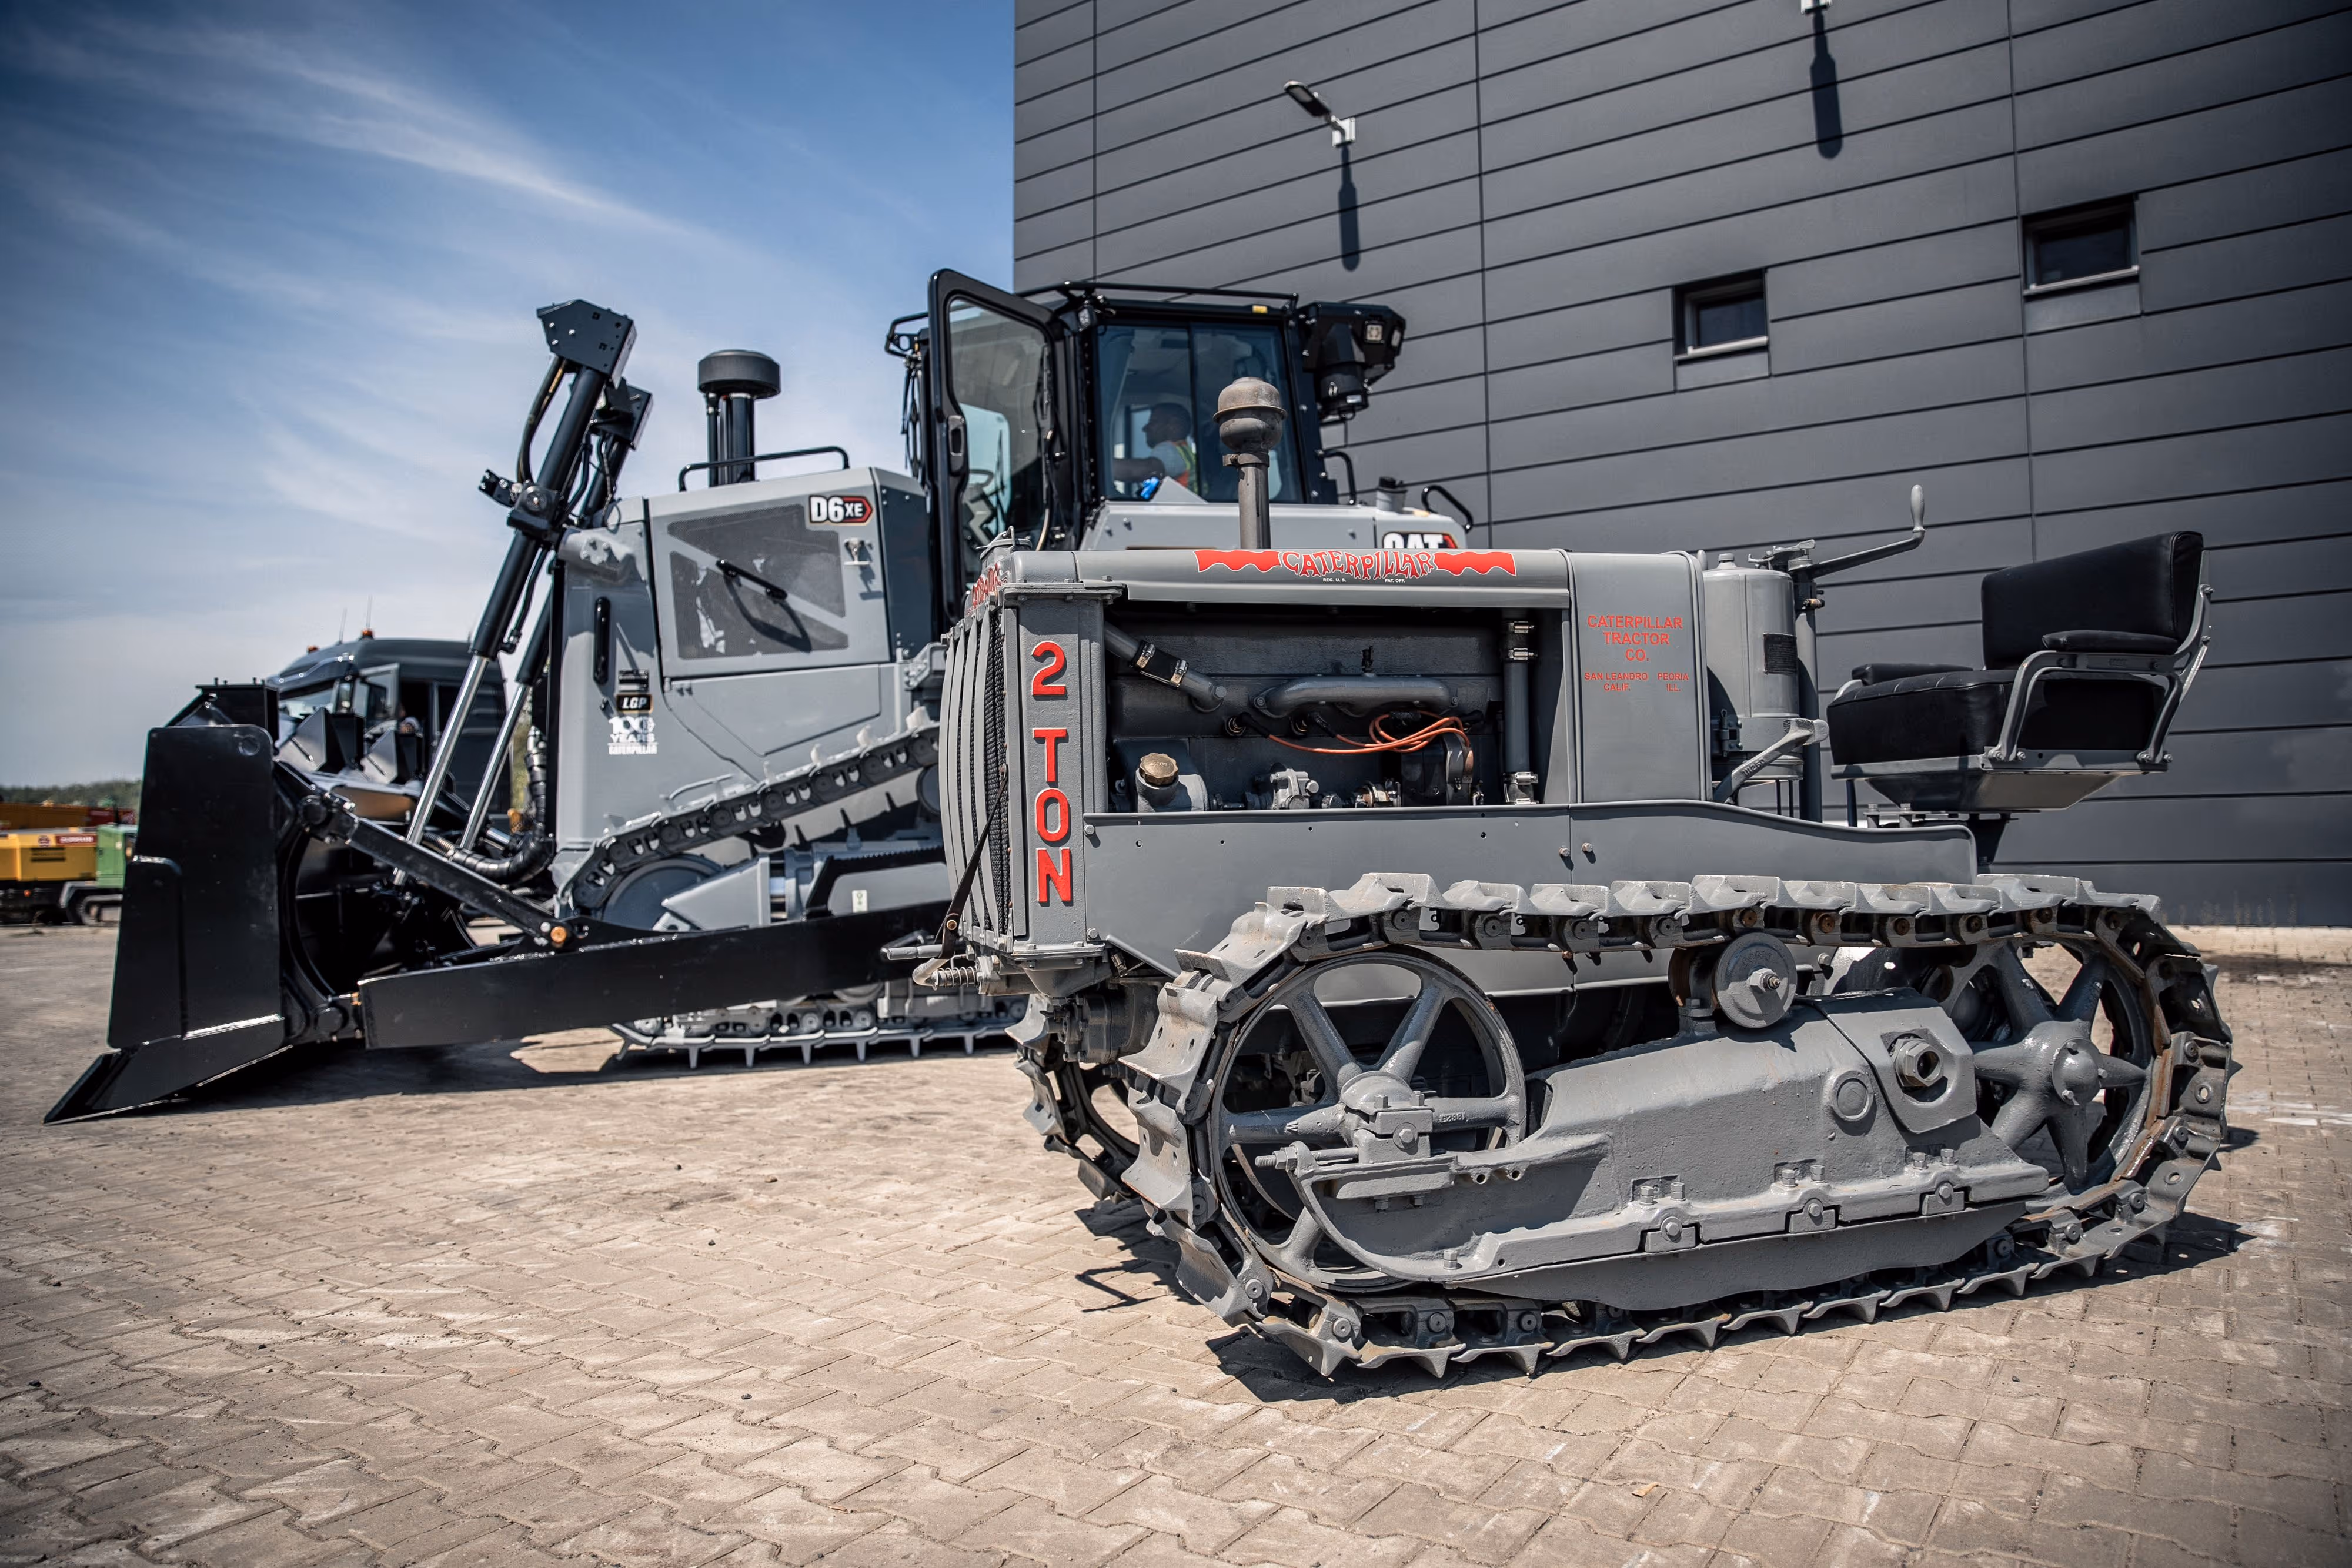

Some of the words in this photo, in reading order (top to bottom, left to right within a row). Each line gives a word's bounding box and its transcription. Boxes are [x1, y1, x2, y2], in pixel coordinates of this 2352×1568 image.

[1282, 550, 1434, 580] CATERPILLAR
[1587, 615, 1683, 629] CATERPILLAR
[1603, 632, 1670, 644] TRACTOR
[1625, 648, 1649, 661] CO.
[1032, 641, 1066, 696] 2
[1584, 672, 1603, 680] SAN
[1605, 672, 1648, 680] LEANDRO
[1603, 683, 1631, 691] CALIF.
[622, 697, 647, 709] LGP
[610, 734, 654, 743] YEARS
[1033, 728, 1073, 903] TON
